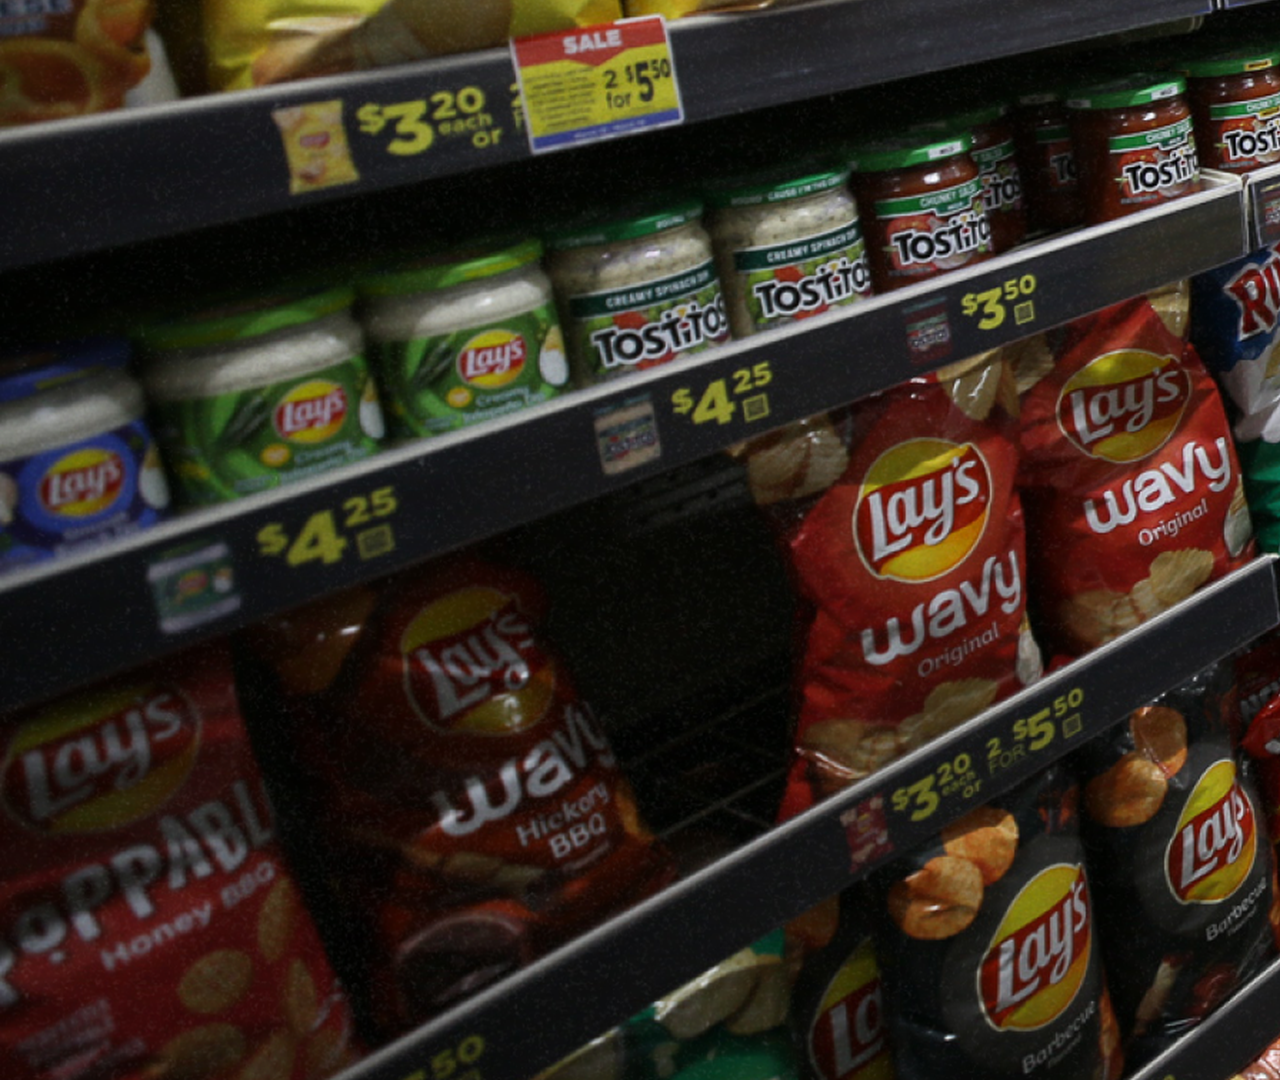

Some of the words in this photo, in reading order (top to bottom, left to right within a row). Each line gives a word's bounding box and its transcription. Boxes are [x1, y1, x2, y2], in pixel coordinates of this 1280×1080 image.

[562, 29, 622, 55] SALE
[604, 70, 618, 89] 2
[606, 90, 632, 110] for
[767, 246, 808, 263] CREAMY
[606, 289, 652, 309] CREAMY
[464, 338, 525, 378] Lay's
[283, 388, 344, 433] Lay's
[1069, 363, 1182, 446] Lay's
[866, 452, 980, 564] Lay's
[1083, 436, 1232, 534] wavy
[1137, 498, 1209, 548] Original
[860, 548, 1022, 667] wavy
[918, 621, 1001, 678] Original
[21, 692, 183, 819] Lay's
[515, 781, 612, 848] Hickory
[550, 814, 607, 862] BBQ
[221, 860, 276, 911] BBQ
[1205, 876, 1268, 942] Barbecue
[102, 905, 214, 971] Honey
[995, 878, 1088, 1013] Lay's
[1021, 1000, 1097, 1076] Barbecue
